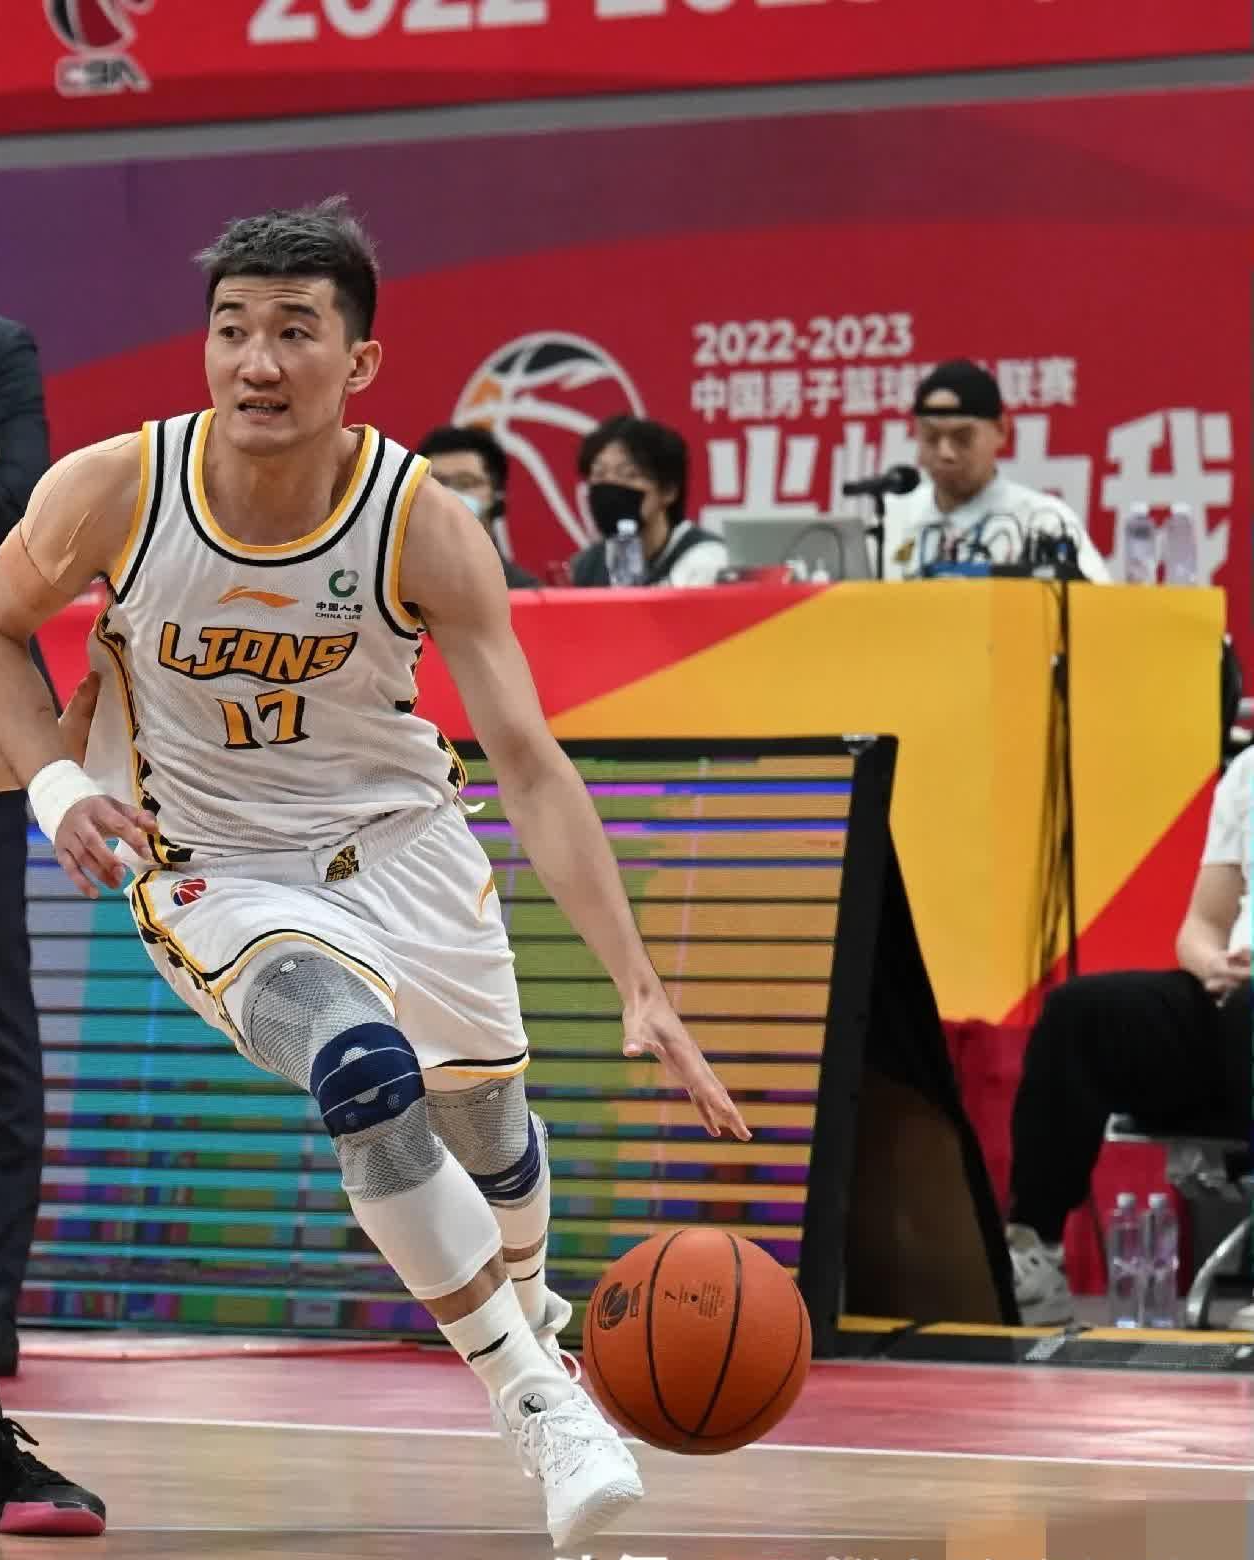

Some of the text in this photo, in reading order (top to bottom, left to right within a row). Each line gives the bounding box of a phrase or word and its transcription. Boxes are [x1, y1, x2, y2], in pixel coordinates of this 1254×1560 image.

[692, 313, 913, 366] 2022-2023
[692, 357, 1076, 423] 中国男子篮球联赛
[315, 601, 363, 613] 中国人寿
[158, 622, 358, 684] LIONS
[214, 688, 310, 749] 17
